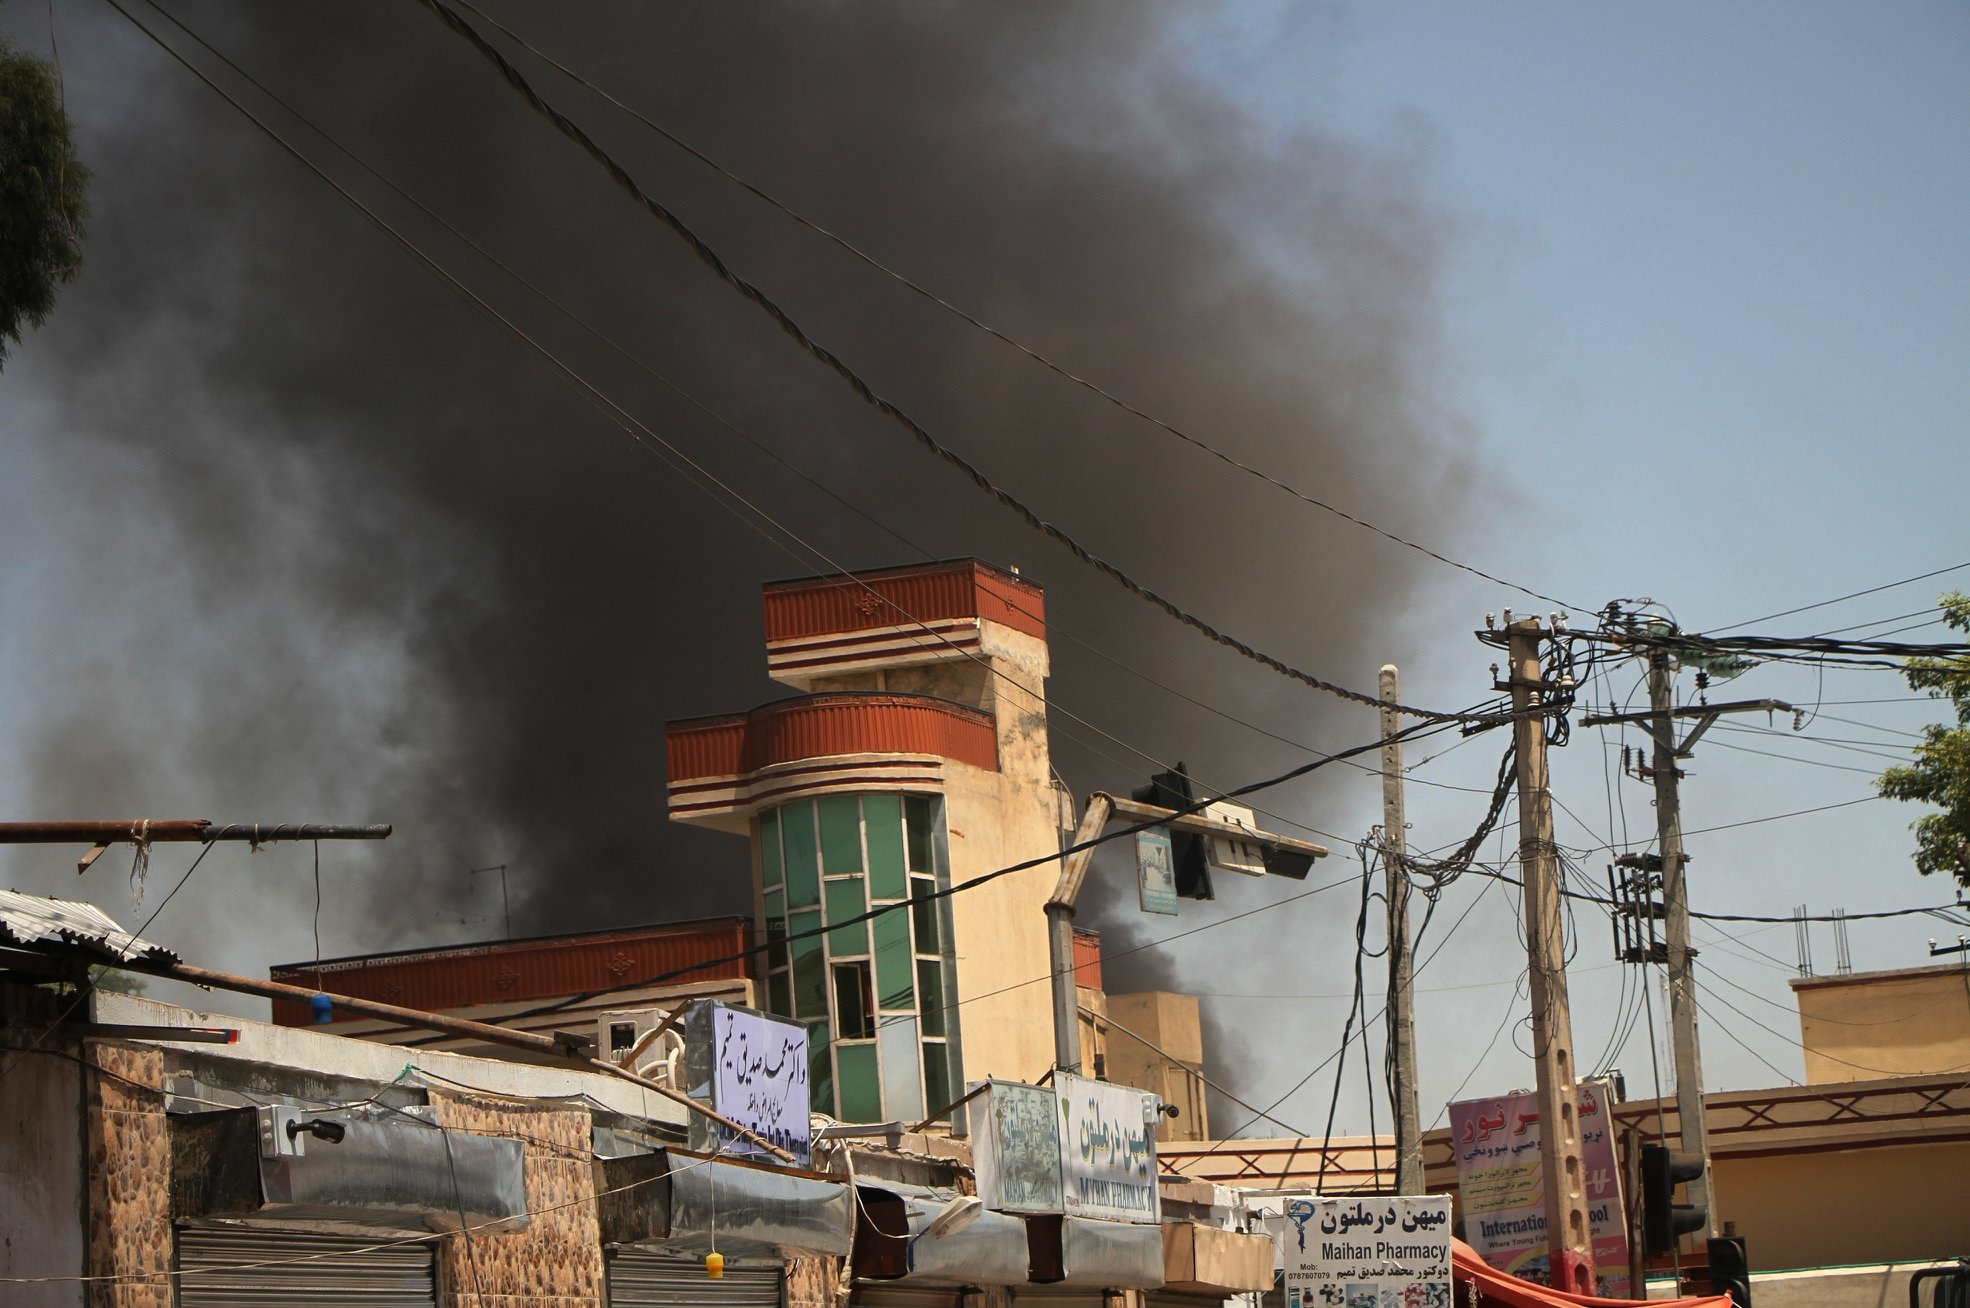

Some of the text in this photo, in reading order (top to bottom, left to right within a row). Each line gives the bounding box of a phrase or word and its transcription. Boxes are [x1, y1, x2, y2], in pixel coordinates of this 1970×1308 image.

[762, 1038, 788, 1079] محمد
[1461, 1101, 1506, 1144] نور
[1402, 1205, 1447, 1233] میهن
[1480, 1214, 1548, 1238] Internatio
[1488, 1240, 1510, 1249] Where
[1512, 1237, 1534, 1247] Young
[1322, 1241, 1447, 1263] Maihan Pharmacy
[1300, 1263, 1319, 1271] Mob:
[1358, 1267, 1385, 1280] صدیق
[1388, 1267, 1414, 1279] محمد
[1288, 1272, 1331, 1280] 0787607079
